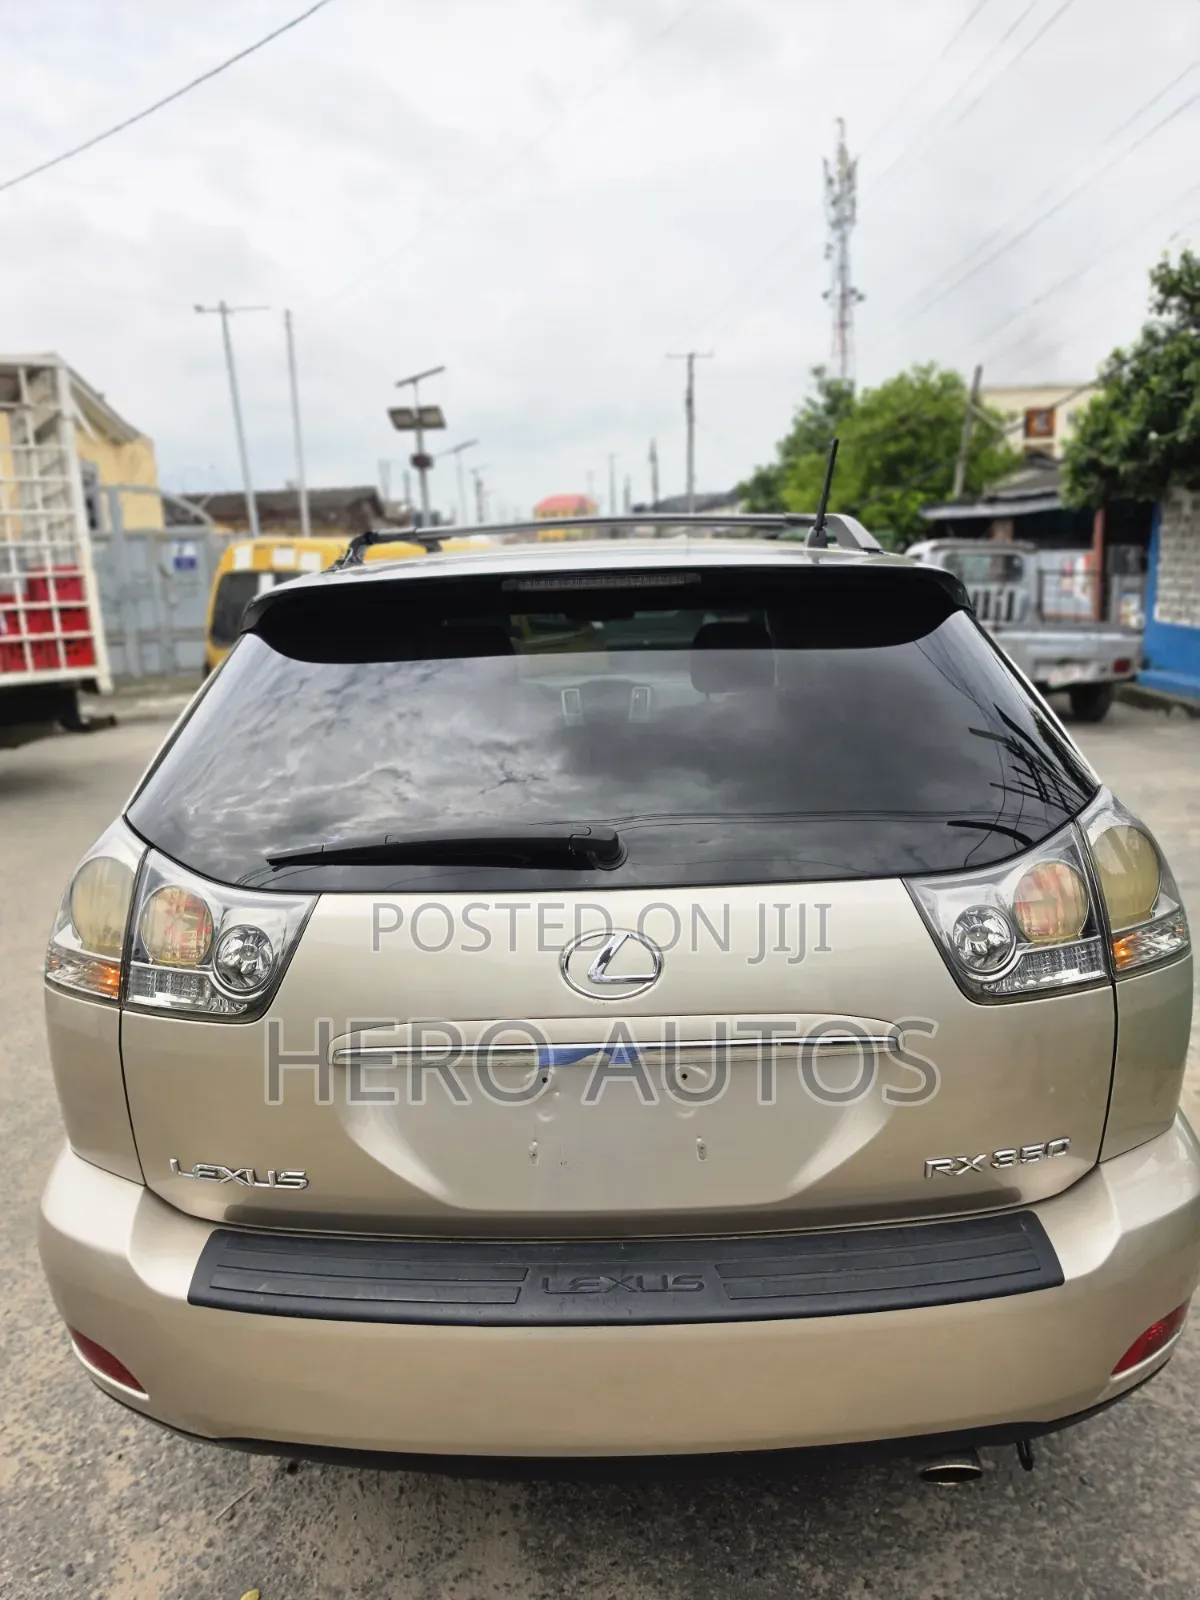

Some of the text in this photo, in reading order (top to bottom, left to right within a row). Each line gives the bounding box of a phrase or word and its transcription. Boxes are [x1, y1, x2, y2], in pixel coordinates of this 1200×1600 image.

[169, 1157, 309, 1190] LEXUS
[924, 1136, 1071, 1179] RX 350
[541, 1274, 705, 1295] LEXUS
